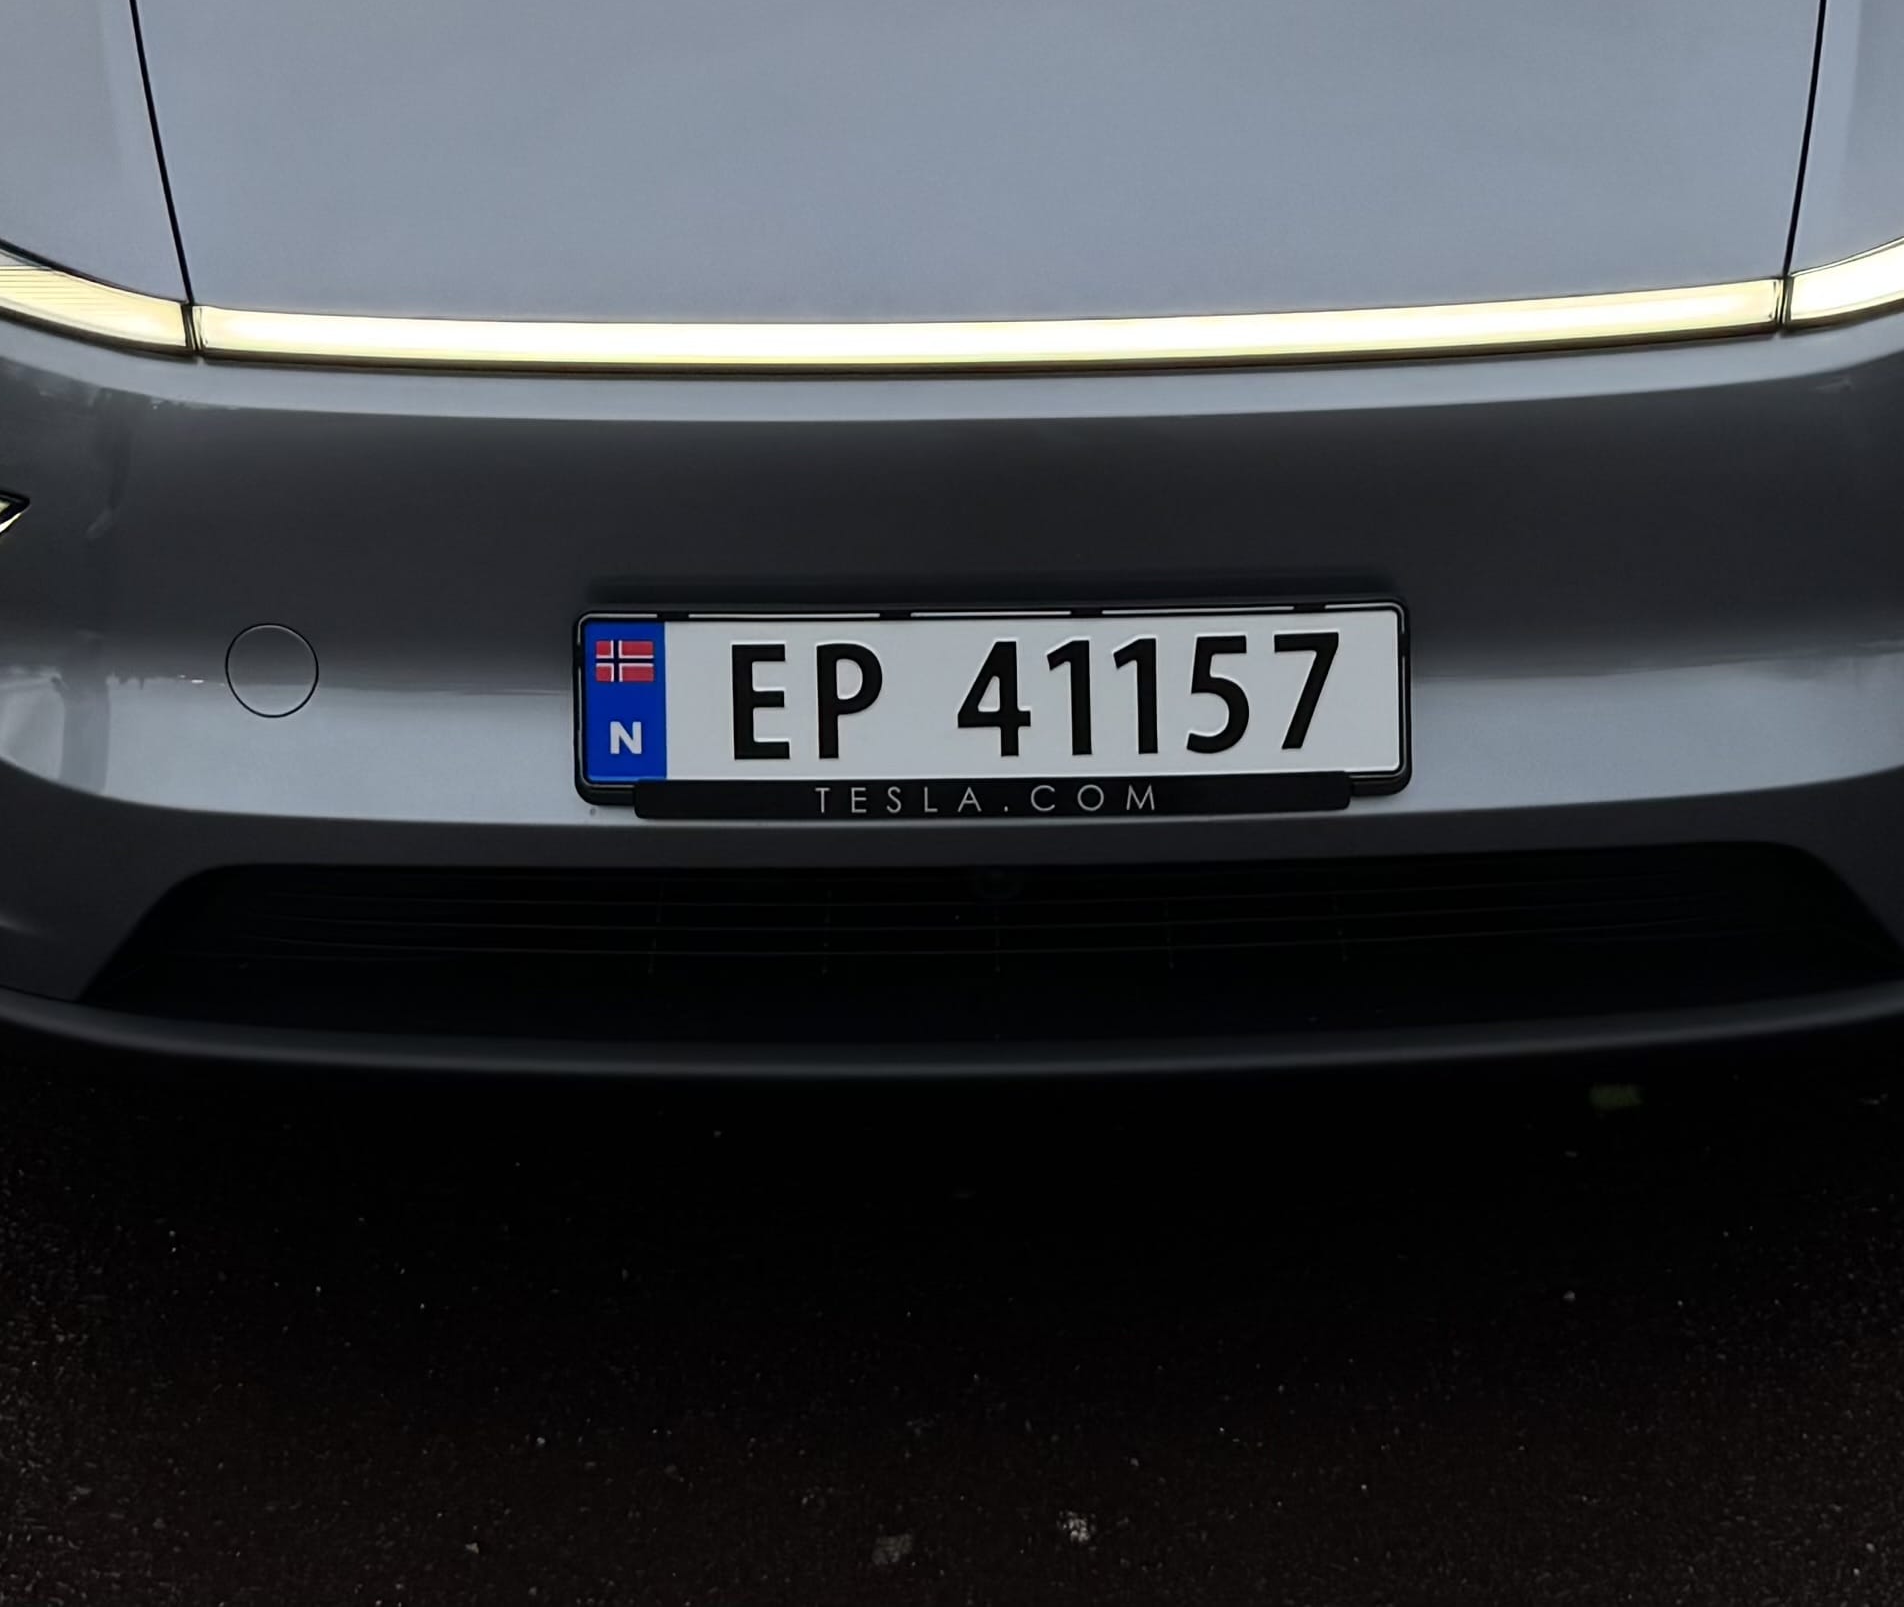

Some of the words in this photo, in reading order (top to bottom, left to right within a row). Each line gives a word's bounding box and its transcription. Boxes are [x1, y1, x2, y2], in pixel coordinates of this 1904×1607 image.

[730, 642, 884, 760] EP
[956, 631, 1341, 758] 41157
[610, 721, 642, 754] N
